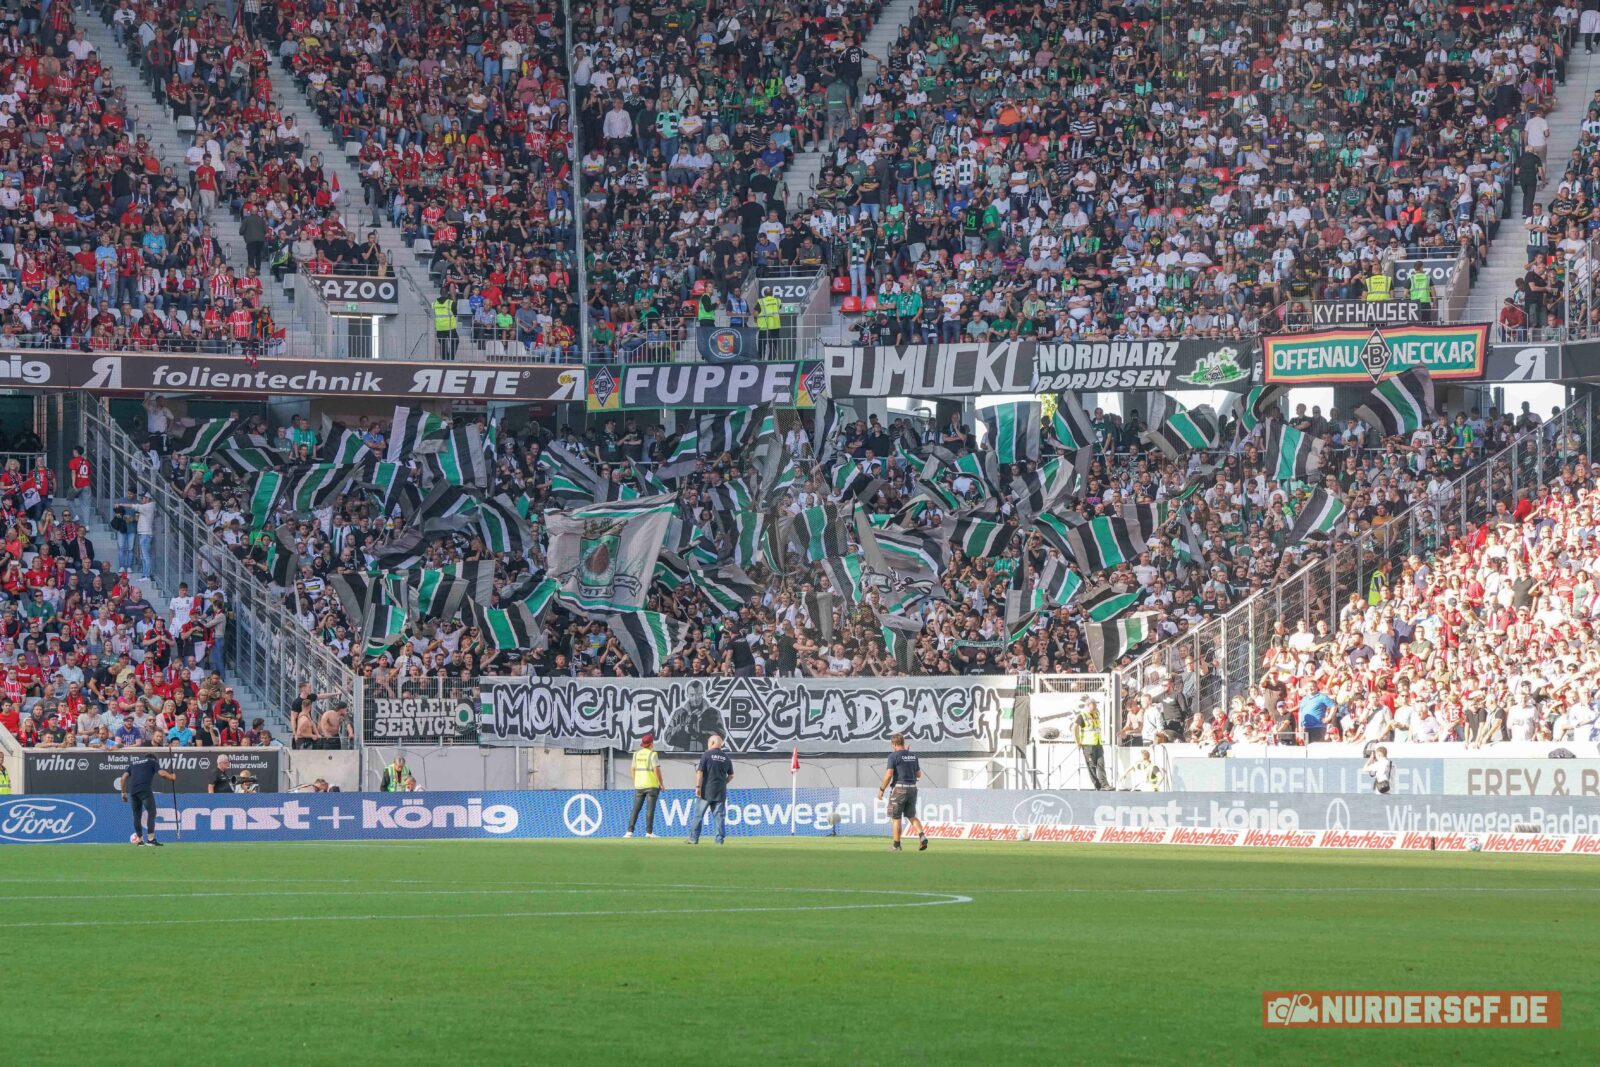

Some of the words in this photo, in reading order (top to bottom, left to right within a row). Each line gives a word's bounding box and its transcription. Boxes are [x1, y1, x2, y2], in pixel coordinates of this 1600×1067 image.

[1314, 300, 1419, 323] KYFFHÄUSER
[1039, 342, 1179, 373] NORDHARZ
[1273, 345, 1358, 371] OFFENAU
[1393, 341, 1475, 365] NECKAR
[152, 365, 383, 392] folientechnik
[825, 341, 1031, 395] PUMUCKL
[625, 364, 795, 404] FUPPE
[1037, 370, 1171, 392] BORUSSEN
[374, 698, 457, 718] BEGLEIT
[493, 677, 682, 746] MÖNCHEN
[766, 685, 1000, 750] GLADBACH
[374, 717, 456, 737] SERVICE
[36, 755, 75, 771] wiha
[108, 755, 128, 763] Made
[158, 753, 196, 770] wiha
[228, 754, 249, 762] Made
[251, 754, 260, 762] im
[228, 762, 268, 770] hwarzwald
[1231, 759, 1324, 793] HÖREN
[2, 804, 75, 834] Ford
[362, 798, 518, 833] könig
[725, 799, 866, 830] bewegen
[1028, 799, 1063, 824] Ford
[1094, 800, 1182, 828] ernst
[1210, 801, 1299, 829] könig
[1385, 805, 1421, 831] Wir
[1031, 824, 1096, 842] WeberHaus
[1100, 825, 1165, 843] WeberHaus
[1169, 826, 1239, 845] WeberHaus
[1243, 828, 1315, 847] WeberHaus
[1319, 830, 1397, 849] WeberHaus
[1483, 833, 1567, 852] WeberHaus
